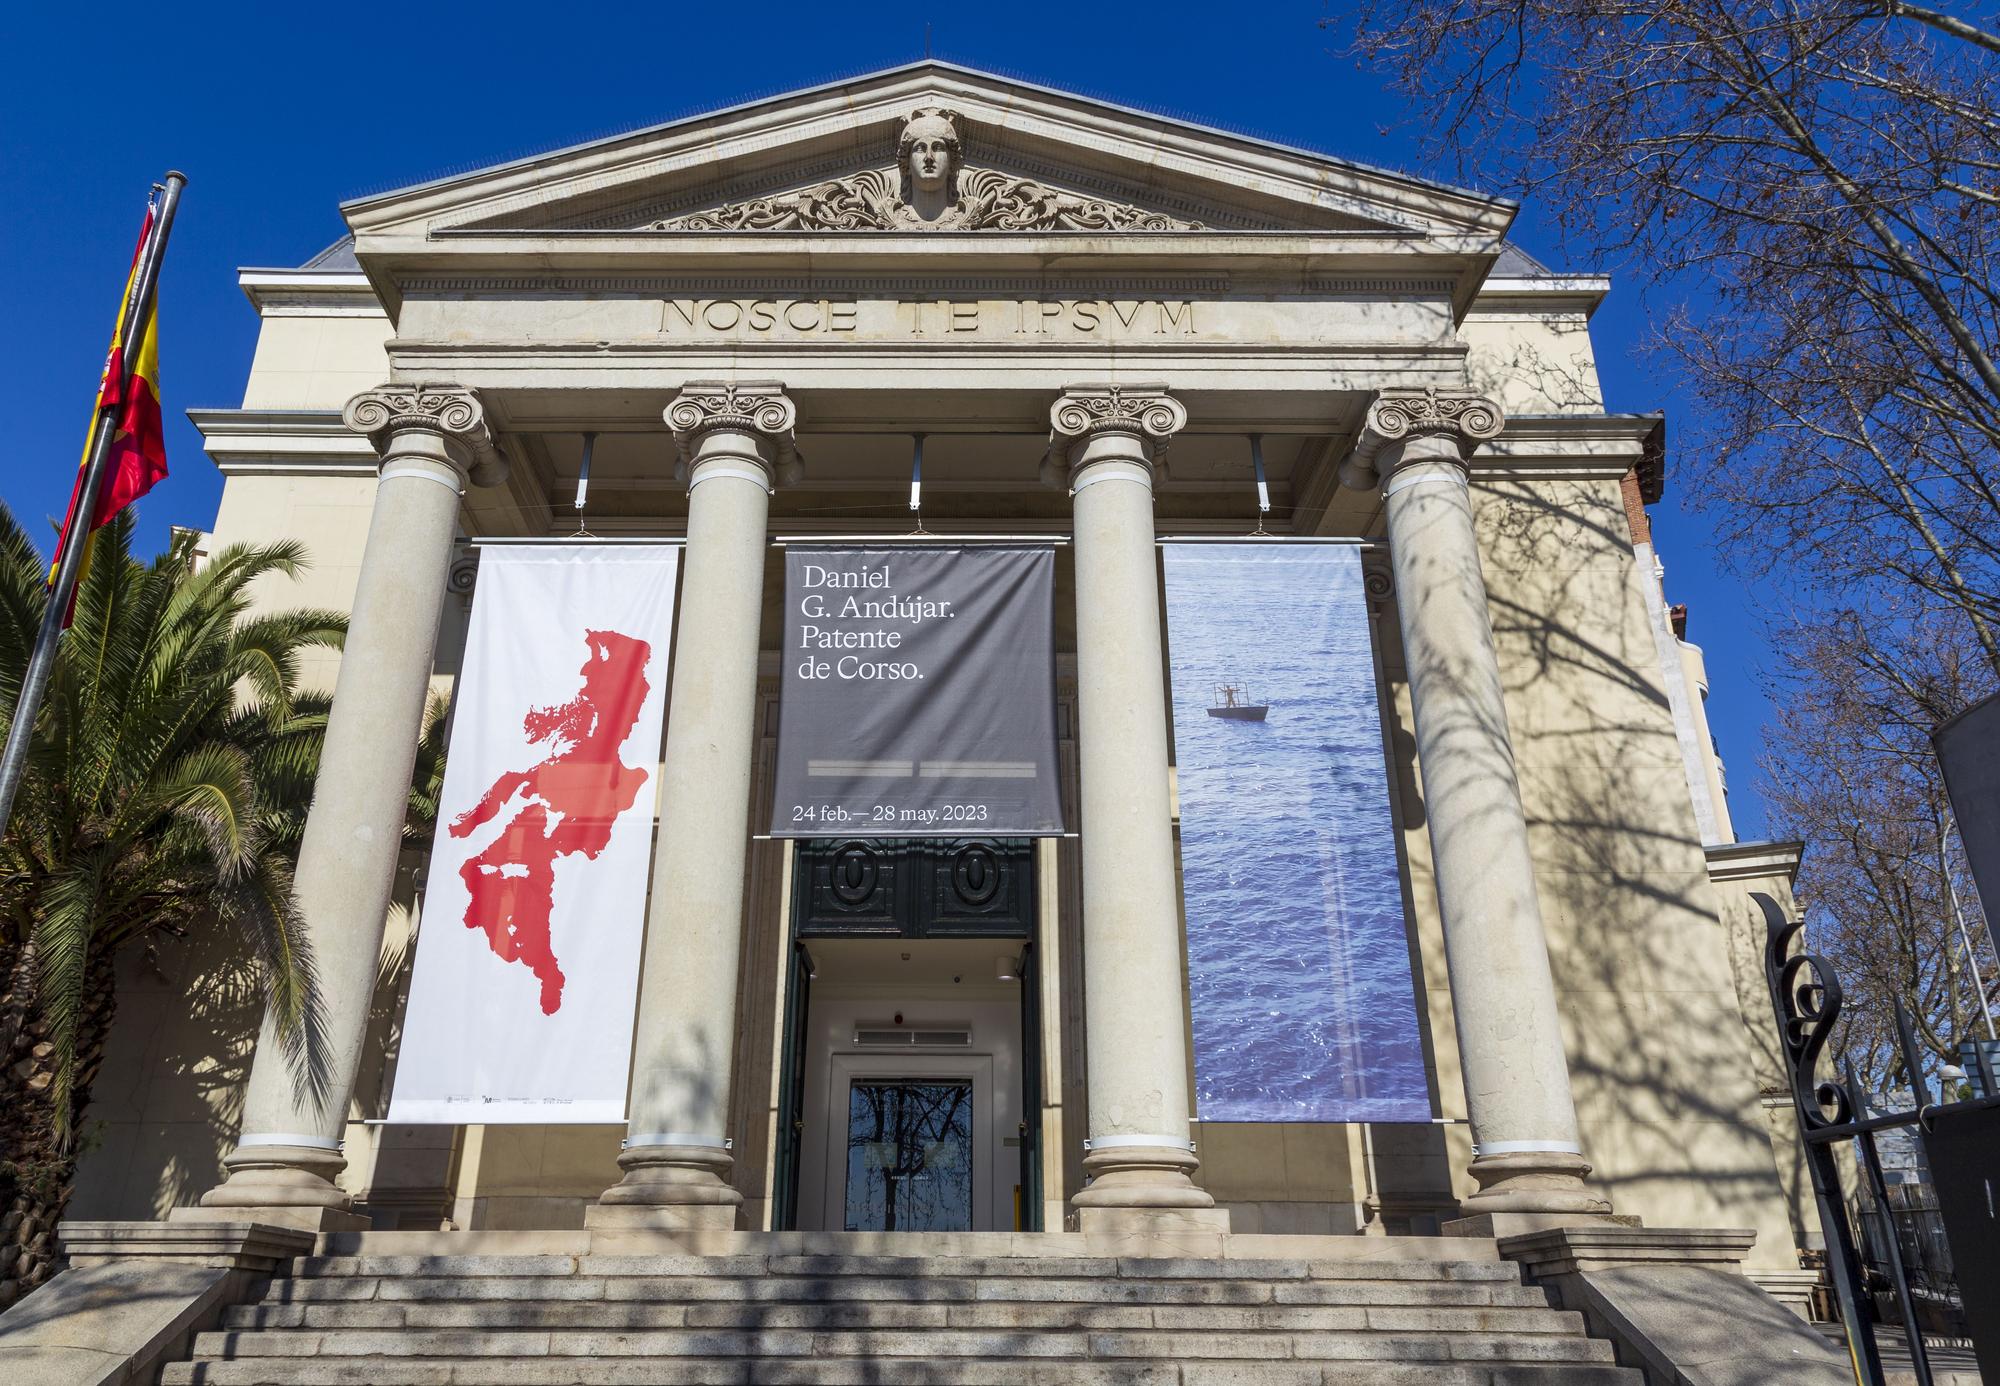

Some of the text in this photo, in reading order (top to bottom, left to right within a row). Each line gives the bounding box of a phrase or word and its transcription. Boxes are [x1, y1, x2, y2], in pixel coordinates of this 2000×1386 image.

[657, 299, 1199, 334] NOSCE TE IPSVM
[802, 565, 892, 589] Daniel
[800, 594, 955, 624] G. Andújar.
[799, 624, 902, 649] Patente
[798, 655, 925, 680] de Corso.
[792, 805, 817, 822] 24
[872, 805, 896, 822] 28
[899, 808, 940, 825] may.
[942, 804, 988, 822] 2023
